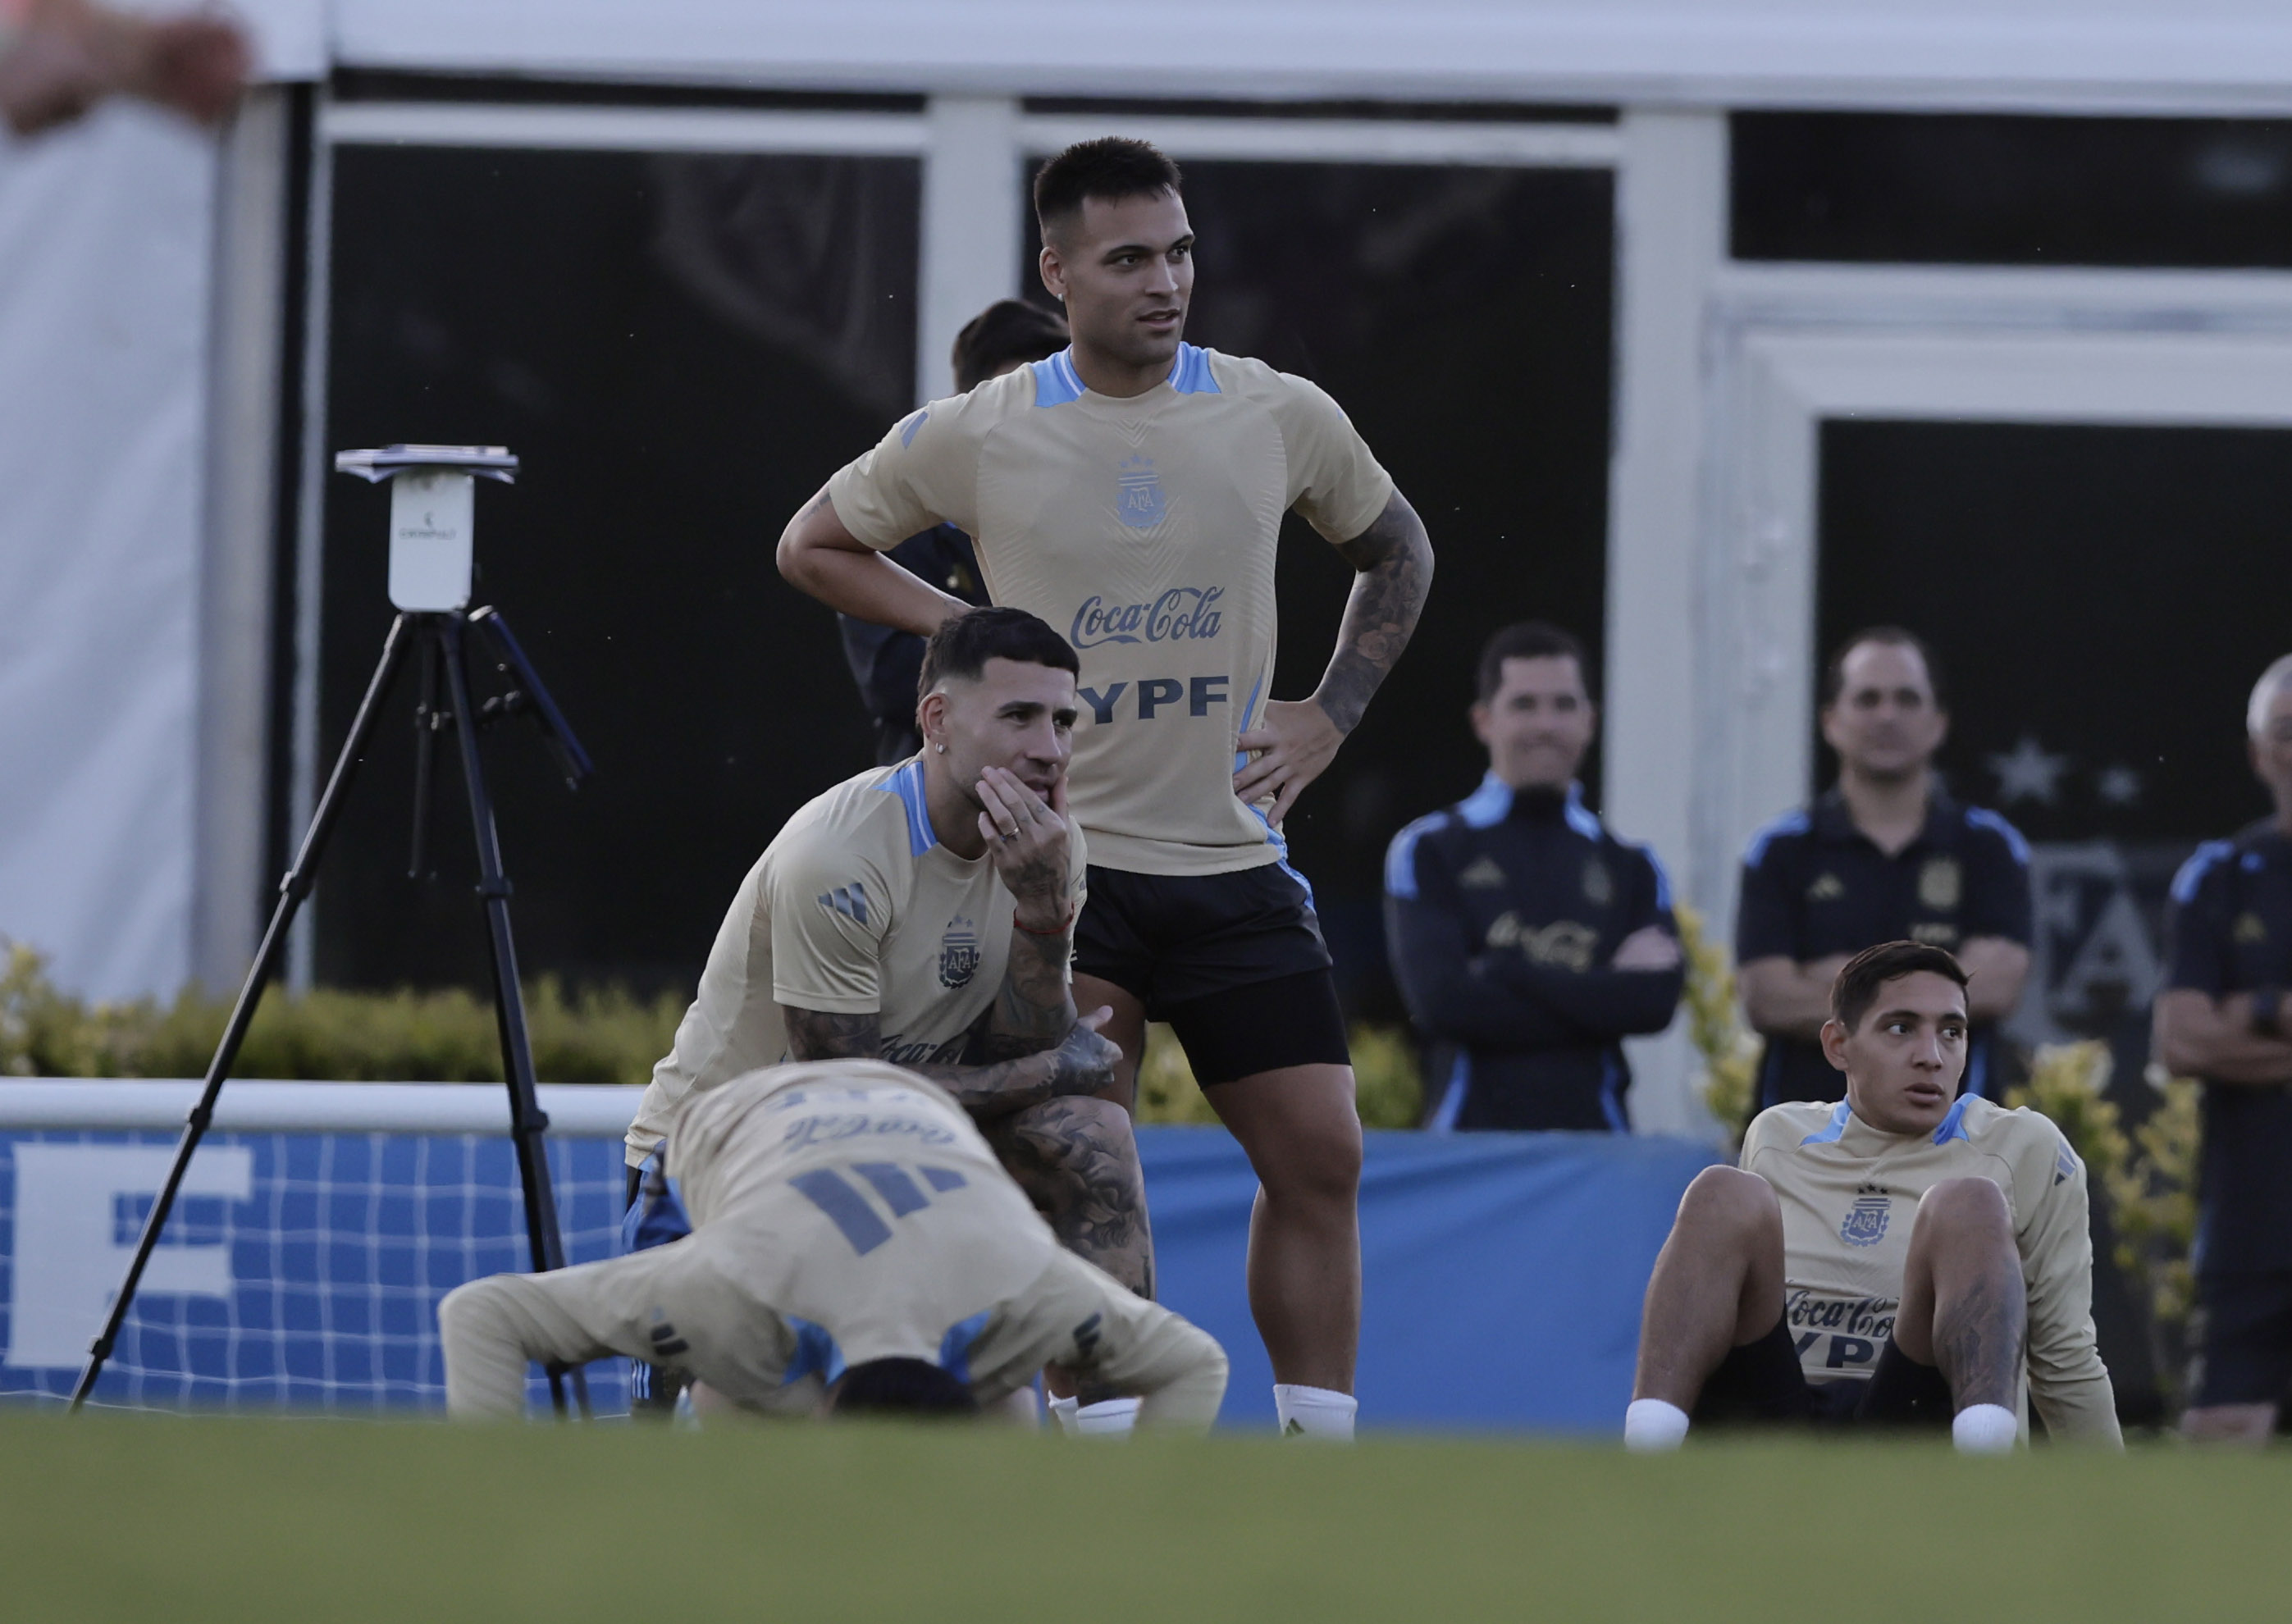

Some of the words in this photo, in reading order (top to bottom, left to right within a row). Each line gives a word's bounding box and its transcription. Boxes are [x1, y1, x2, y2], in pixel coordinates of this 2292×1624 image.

[1071, 586, 1226, 649] Coca-Cola
[1076, 675, 1230, 725] YPF
[947, 947, 974, 974] AFA
[1851, 1210, 1878, 1232] AFA
